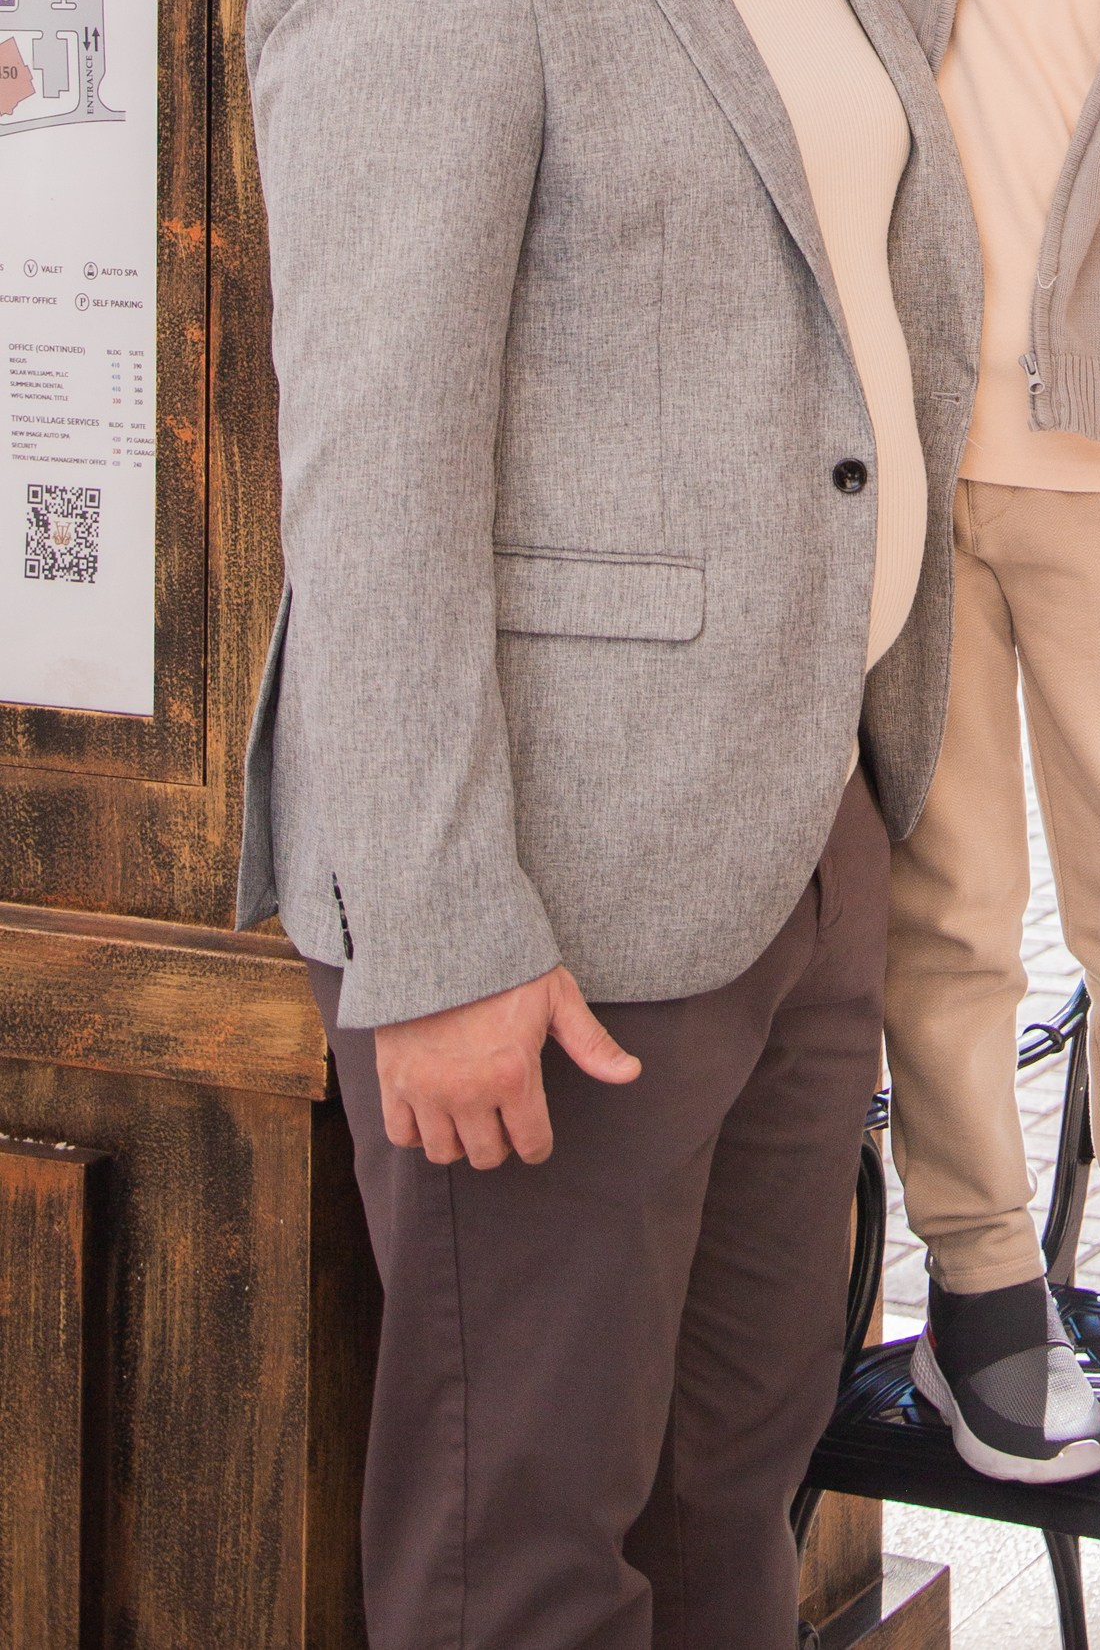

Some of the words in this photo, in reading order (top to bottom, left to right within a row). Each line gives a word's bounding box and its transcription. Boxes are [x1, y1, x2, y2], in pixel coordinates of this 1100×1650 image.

[41, 265, 63, 273] VALET
[0, 295, 30, 304] ECURITY
[32, 296, 57, 305] OFFICE
[92, 299, 109, 307] SELF
[110, 300, 143, 309] PARKING
[9, 343, 34, 351] OFFICE
[36, 345, 86, 356] (CONTINUED)
[11, 415, 35, 423] TIVOLI
[36, 416, 65, 425] VILLAGE
[67, 418, 100, 426] SERVICES
